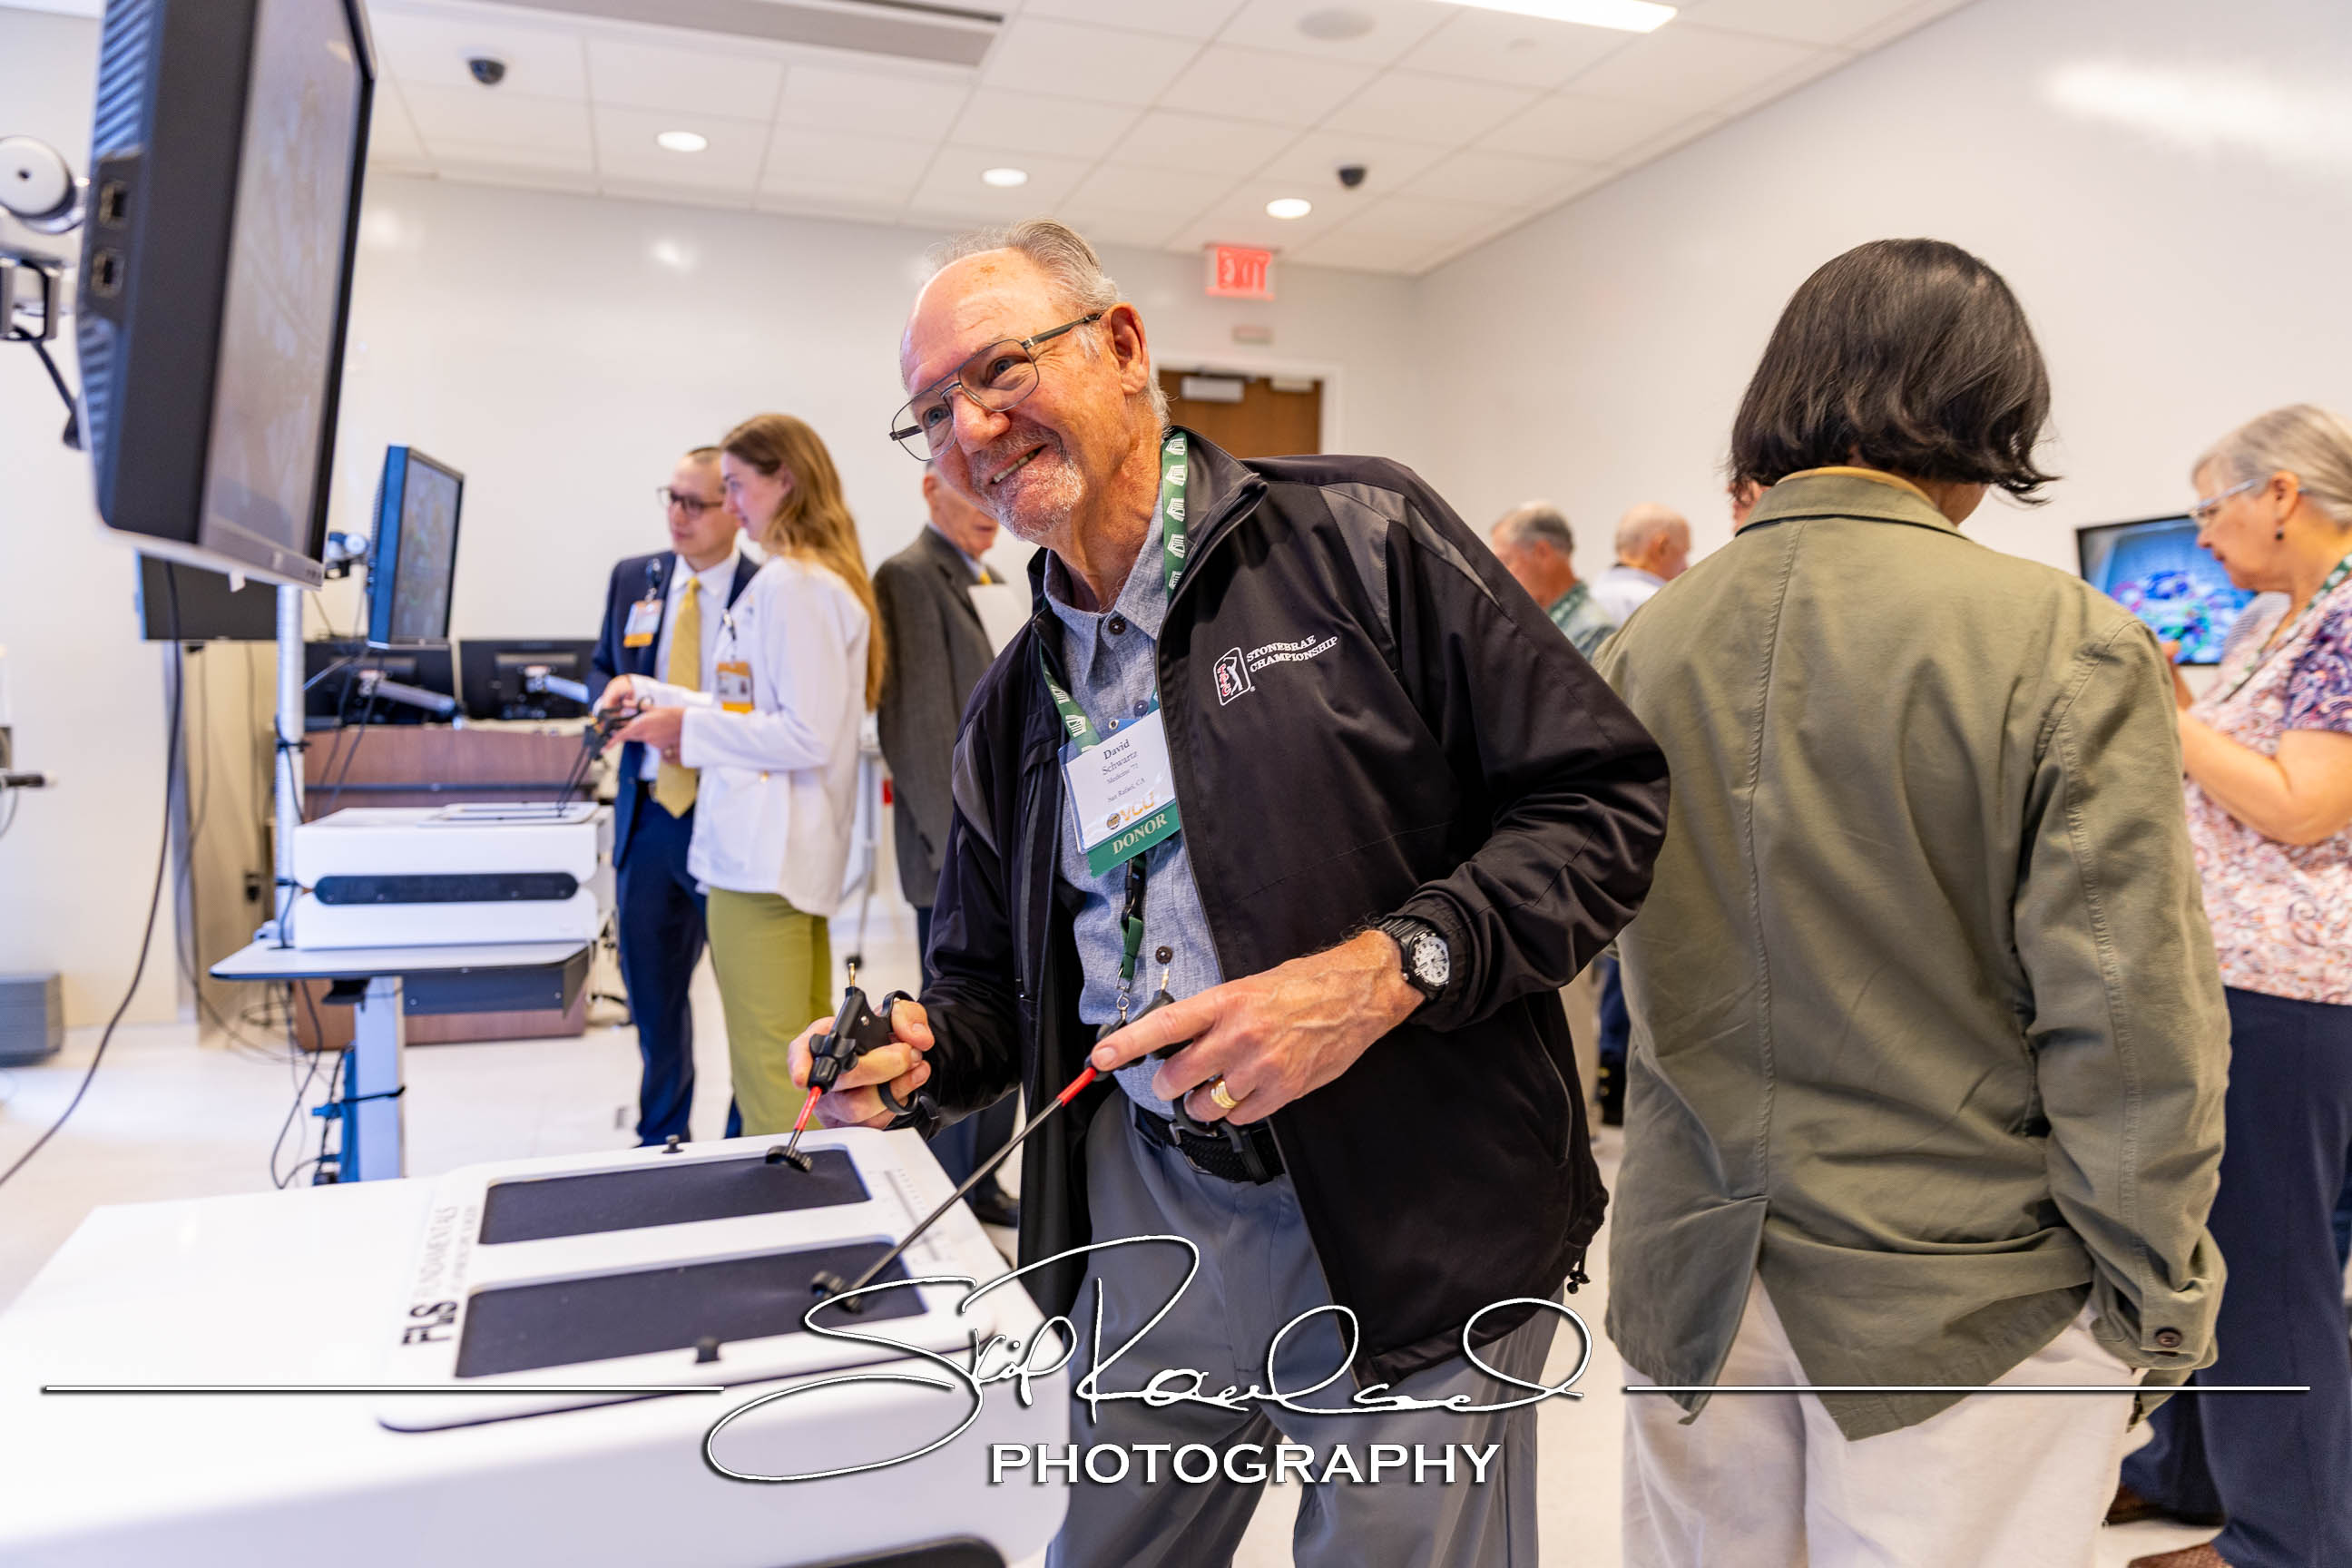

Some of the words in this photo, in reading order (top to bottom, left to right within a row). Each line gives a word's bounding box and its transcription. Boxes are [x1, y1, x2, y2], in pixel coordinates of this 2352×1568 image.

[1246, 635, 1317, 663] STONEBRAE
[1250, 636, 1338, 672] CHAMPIONSHIP
[1102, 739, 1131, 760] David
[1102, 750, 1139, 776] Schwartz
[1112, 813, 1168, 855] DONOR
